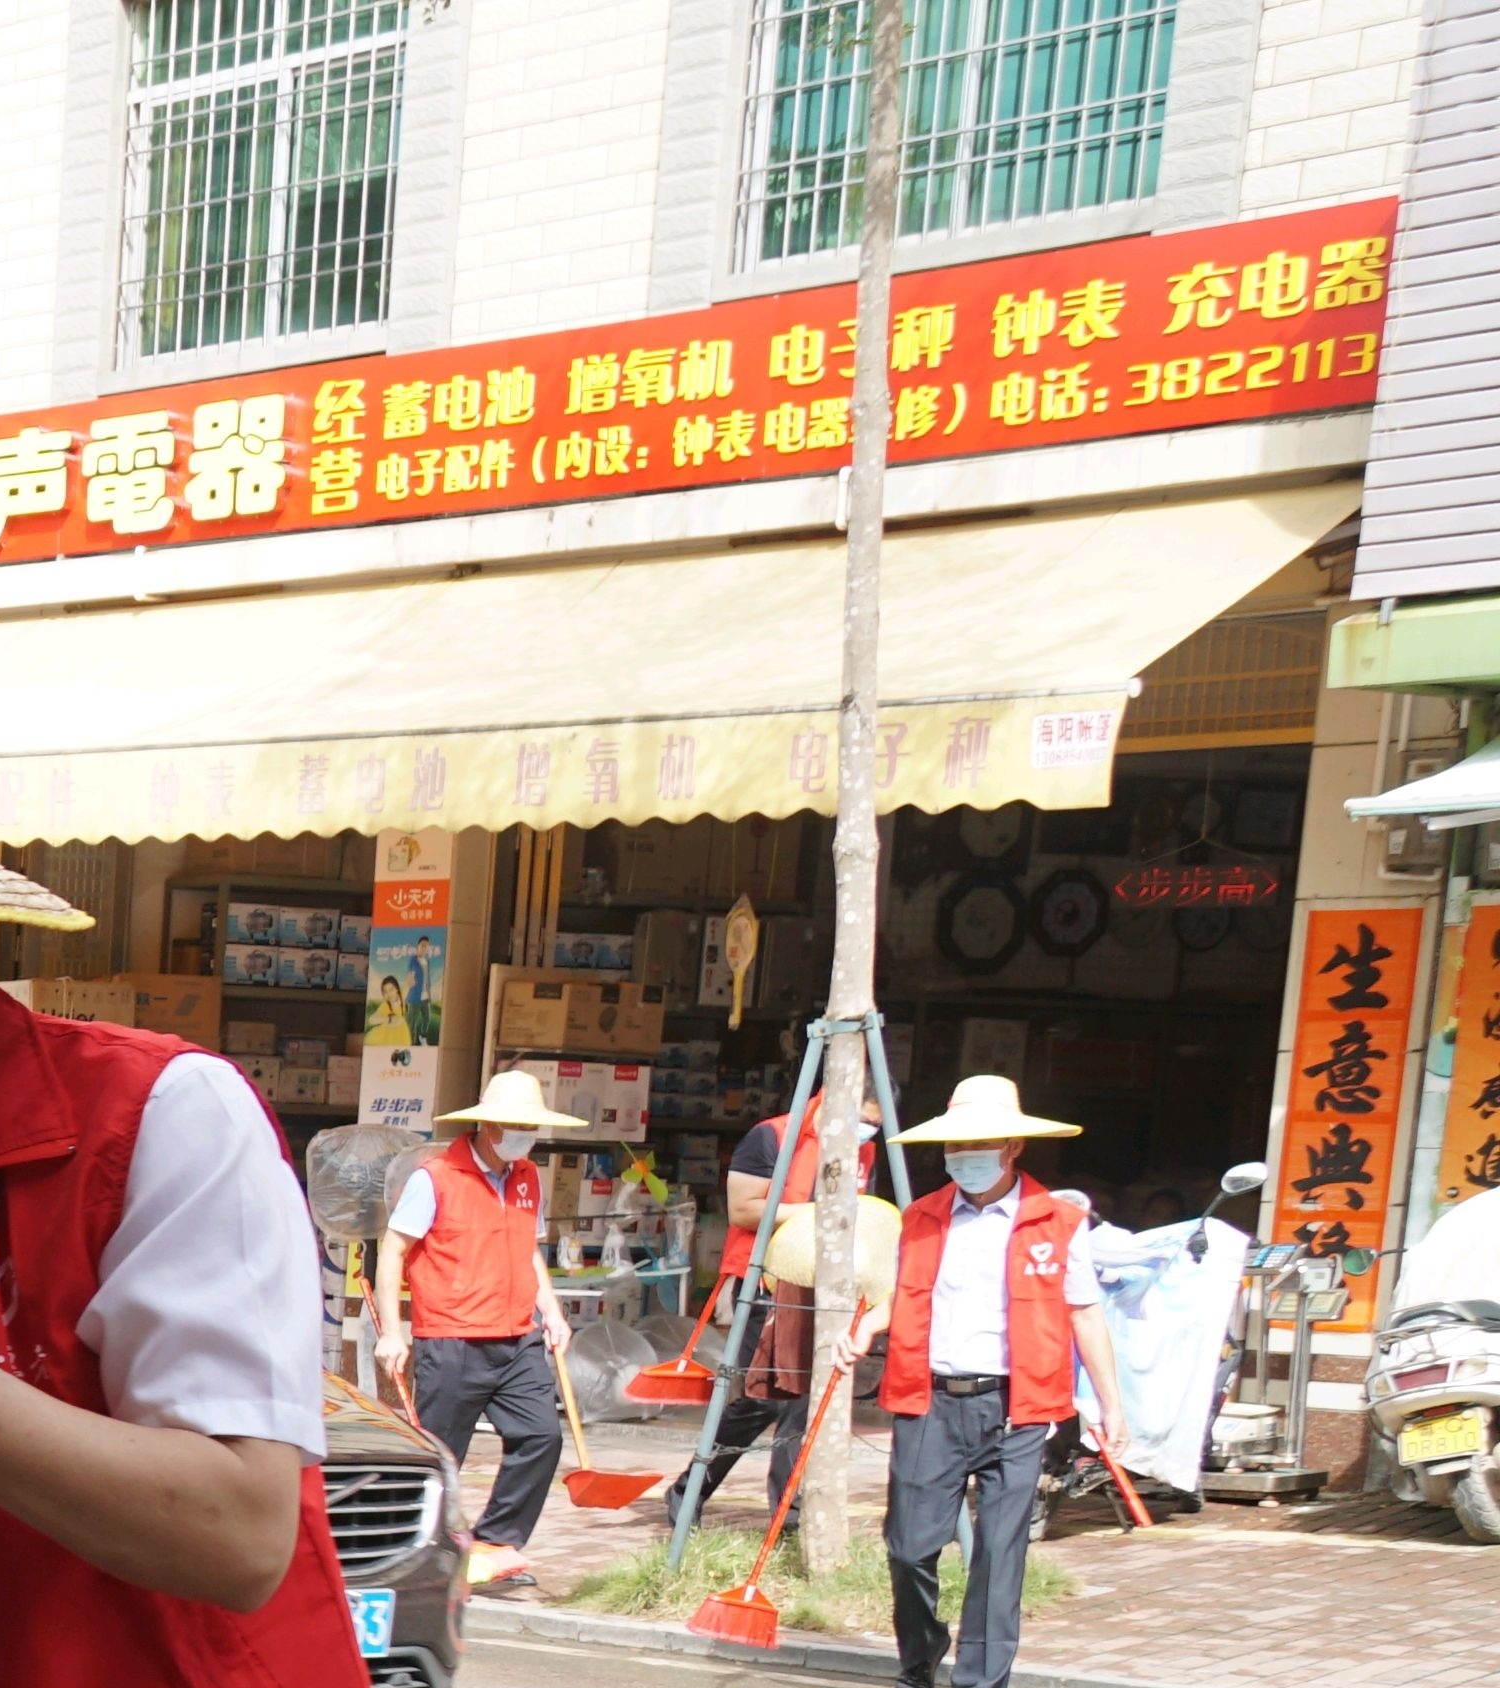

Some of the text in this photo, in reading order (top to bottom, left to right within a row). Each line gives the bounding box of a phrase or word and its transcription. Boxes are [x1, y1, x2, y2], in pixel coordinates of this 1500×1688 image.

[382, 365, 535, 442] 蓄电池
[565, 340, 734, 415] 增氧机
[991, 279, 1127, 359] 钟表
[1163, 236, 1388, 335] 充电器
[298, 748, 447, 816] 蓄电池
[512, 734, 698, 806] 增氧机
[387, 888, 436, 910] 小天才
[370, 1098, 424, 1113] 步步高
